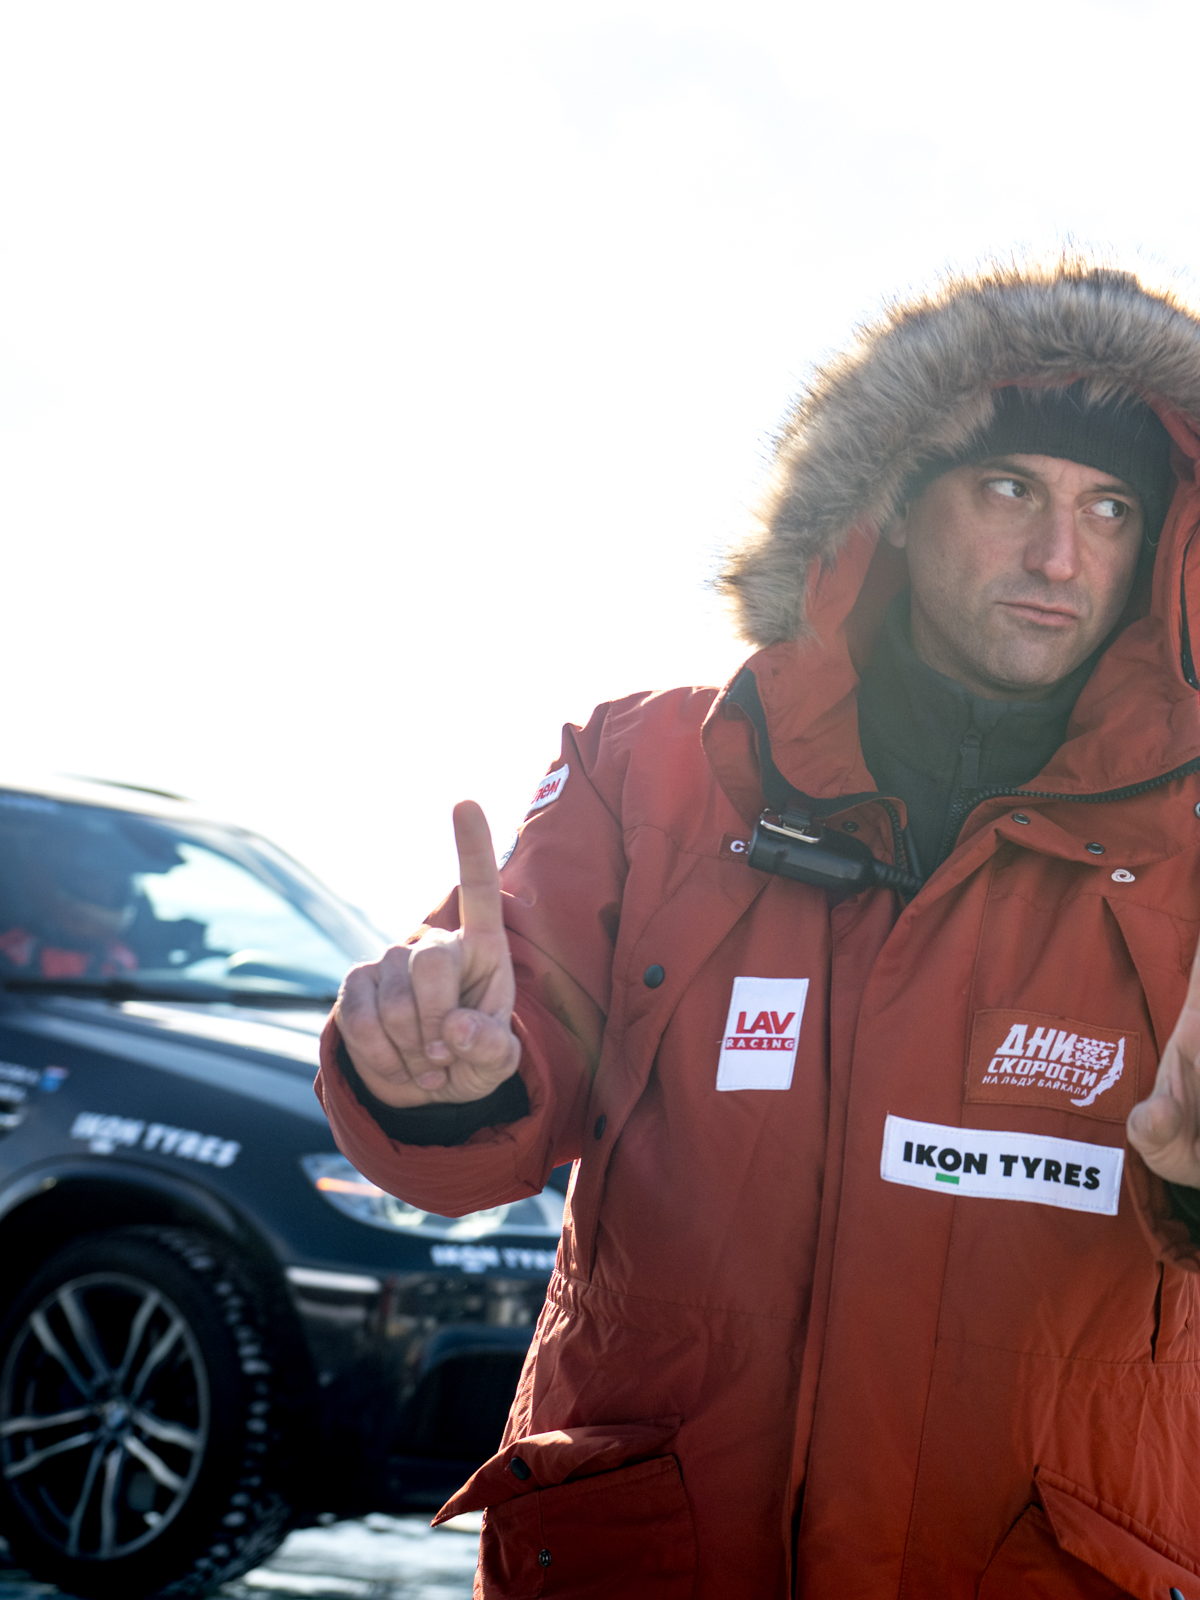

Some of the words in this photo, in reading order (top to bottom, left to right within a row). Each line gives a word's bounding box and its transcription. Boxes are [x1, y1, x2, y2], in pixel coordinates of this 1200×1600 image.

[735, 1010, 797, 1035] LAV
[726, 1038, 795, 1049] RACING
[994, 1023, 1078, 1064] ДНИ
[982, 1075, 999, 1085] НА
[1000, 1075, 1036, 1087] ЛЬДУ
[1037, 1078, 1088, 1097] БАЙКАЛА
[987, 1057, 1098, 1088] СКОРОСТИ
[903, 1141, 988, 1175] IKON
[999, 1154, 1101, 1190] TYRES
